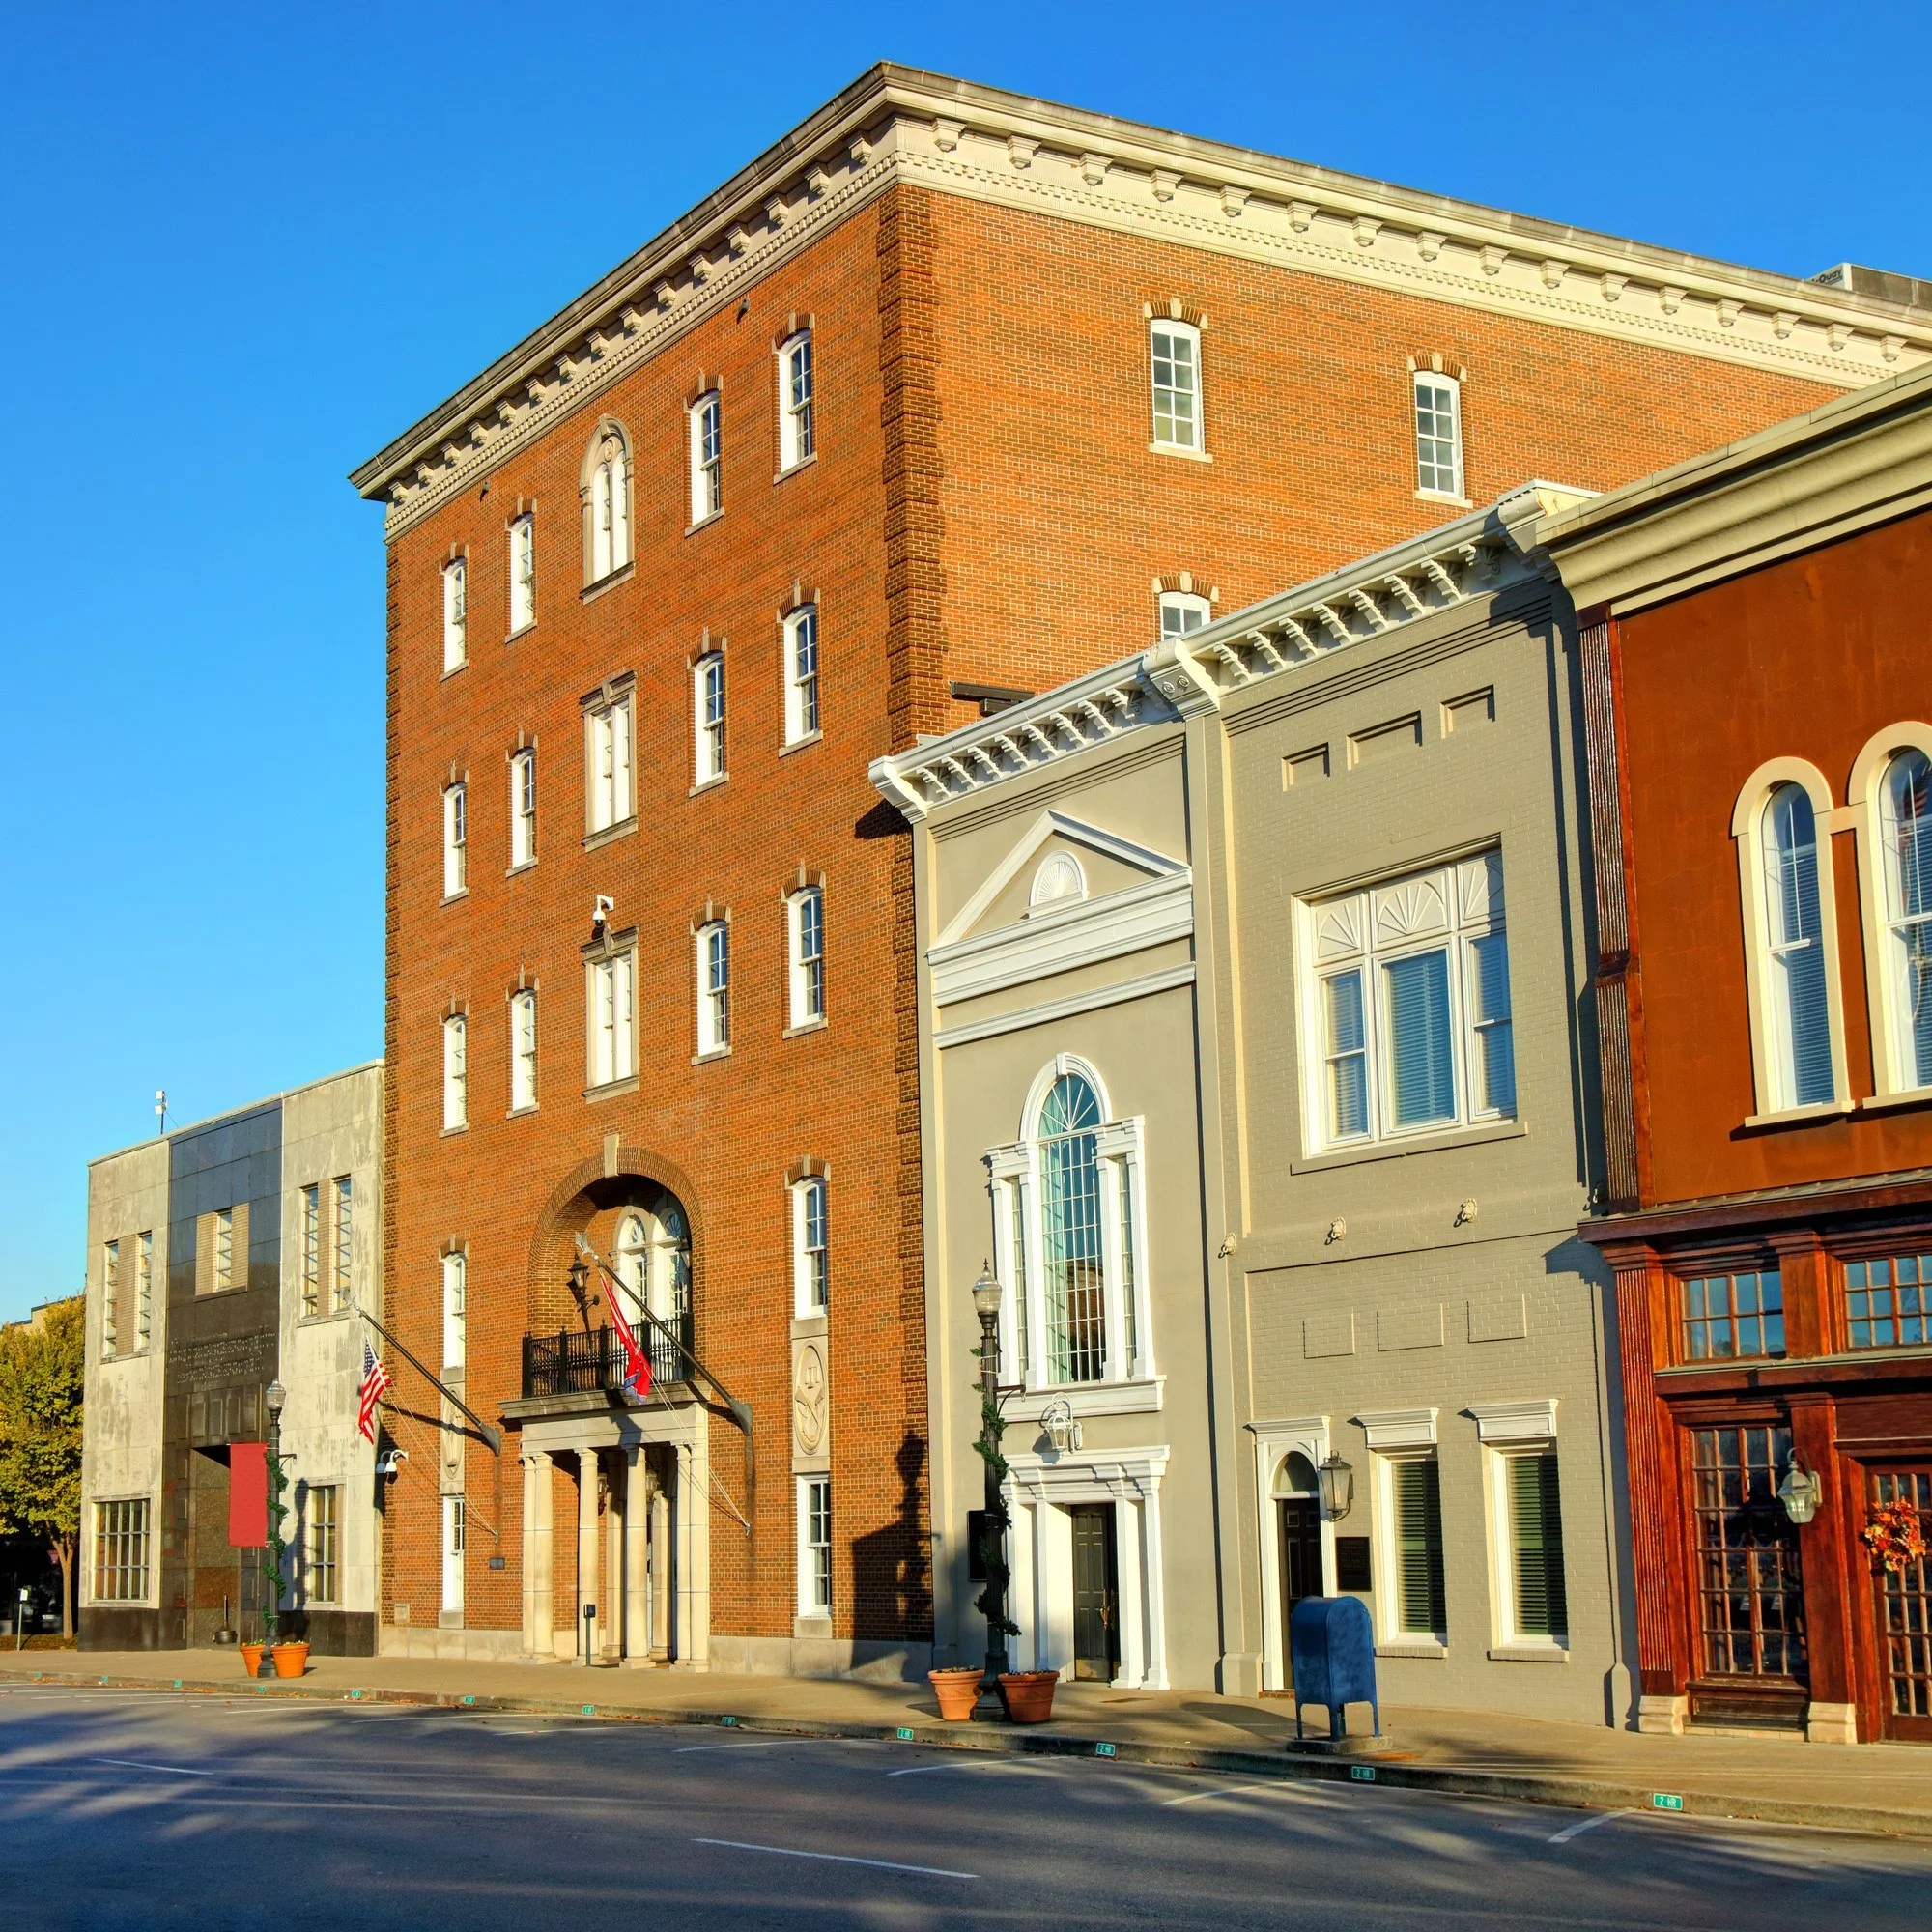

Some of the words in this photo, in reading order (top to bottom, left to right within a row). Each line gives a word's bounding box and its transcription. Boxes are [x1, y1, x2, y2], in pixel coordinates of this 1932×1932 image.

[1099, 1745, 1104, 1753] 2
[1356, 1769, 1361, 1777] 2
[1363, 1770, 1370, 1778] HR
[1660, 1797, 1664, 1806] 2
[1667, 1798, 1677, 1808] HR
